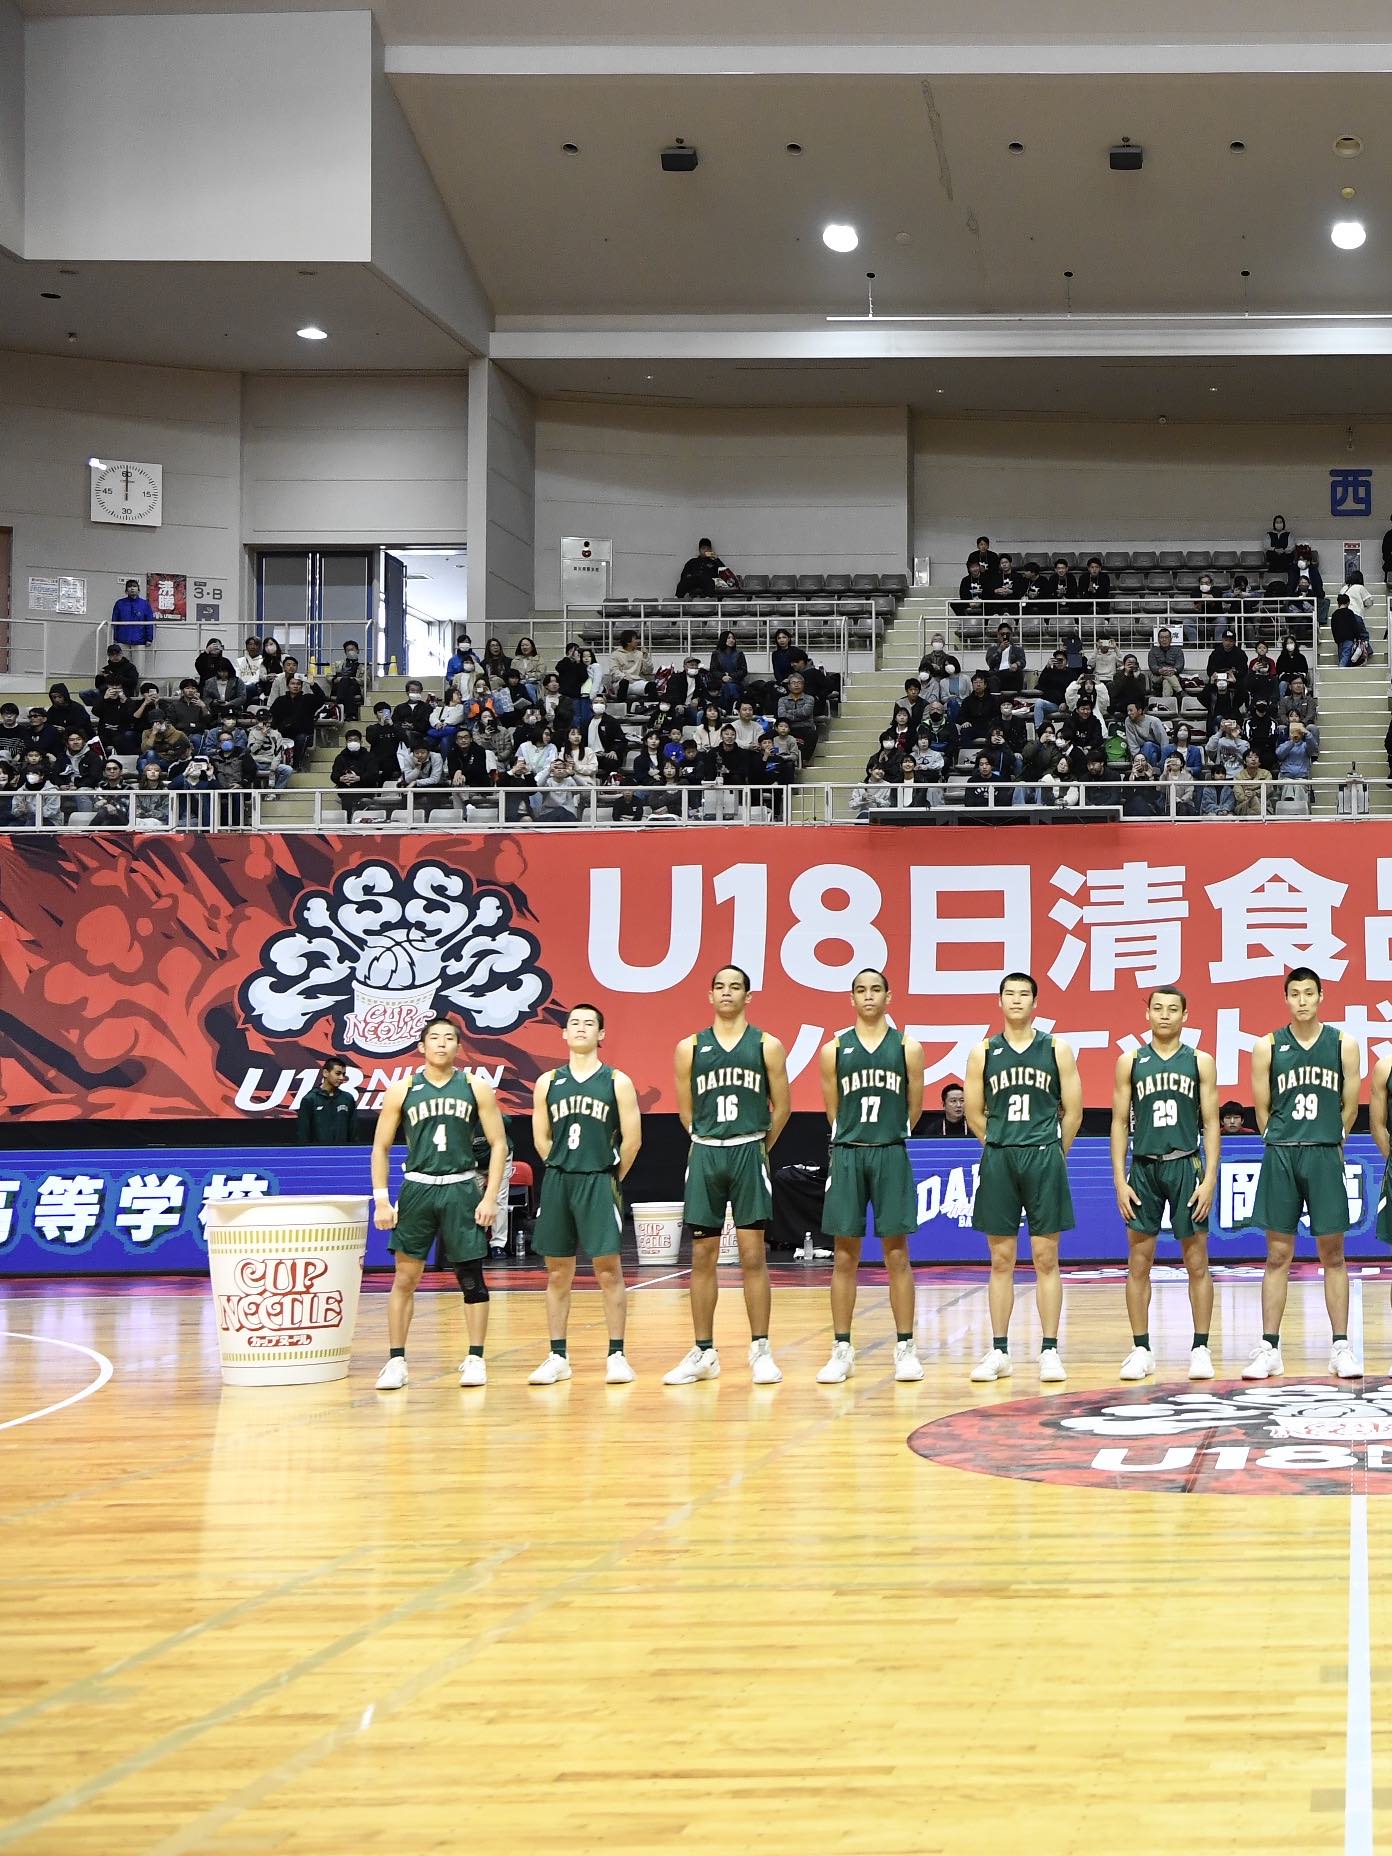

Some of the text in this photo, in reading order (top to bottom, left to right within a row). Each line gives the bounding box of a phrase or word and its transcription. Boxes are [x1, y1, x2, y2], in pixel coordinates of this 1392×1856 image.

[1330, 469, 1372, 516] 西
[696, 1067, 761, 1095] DAIICHI
[841, 1068, 901, 1096] DAIICHI
[989, 1067, 1051, 1095] DAIICHI
[1136, 1072, 1194, 1101] DAIICHI
[1277, 1066, 1339, 1093] DAIICHI
[407, 1098, 472, 1126] DAIICHI
[551, 1095, 609, 1122] DAIICHI
[716, 1094, 738, 1122] 16
[860, 1096, 881, 1122] 17
[1007, 1094, 1030, 1122] 21
[1152, 1099, 1178, 1127] 29
[1291, 1093, 1318, 1120] 39
[432, 1124, 447, 1151] 4
[567, 1123, 582, 1150] 8
[234, 1258, 328, 1294] CUP
[218, 1290, 344, 1331] NOODLE
[250, 1334, 311, 1347] カップヌードル
[1090, 1444, 1359, 1471] U18
